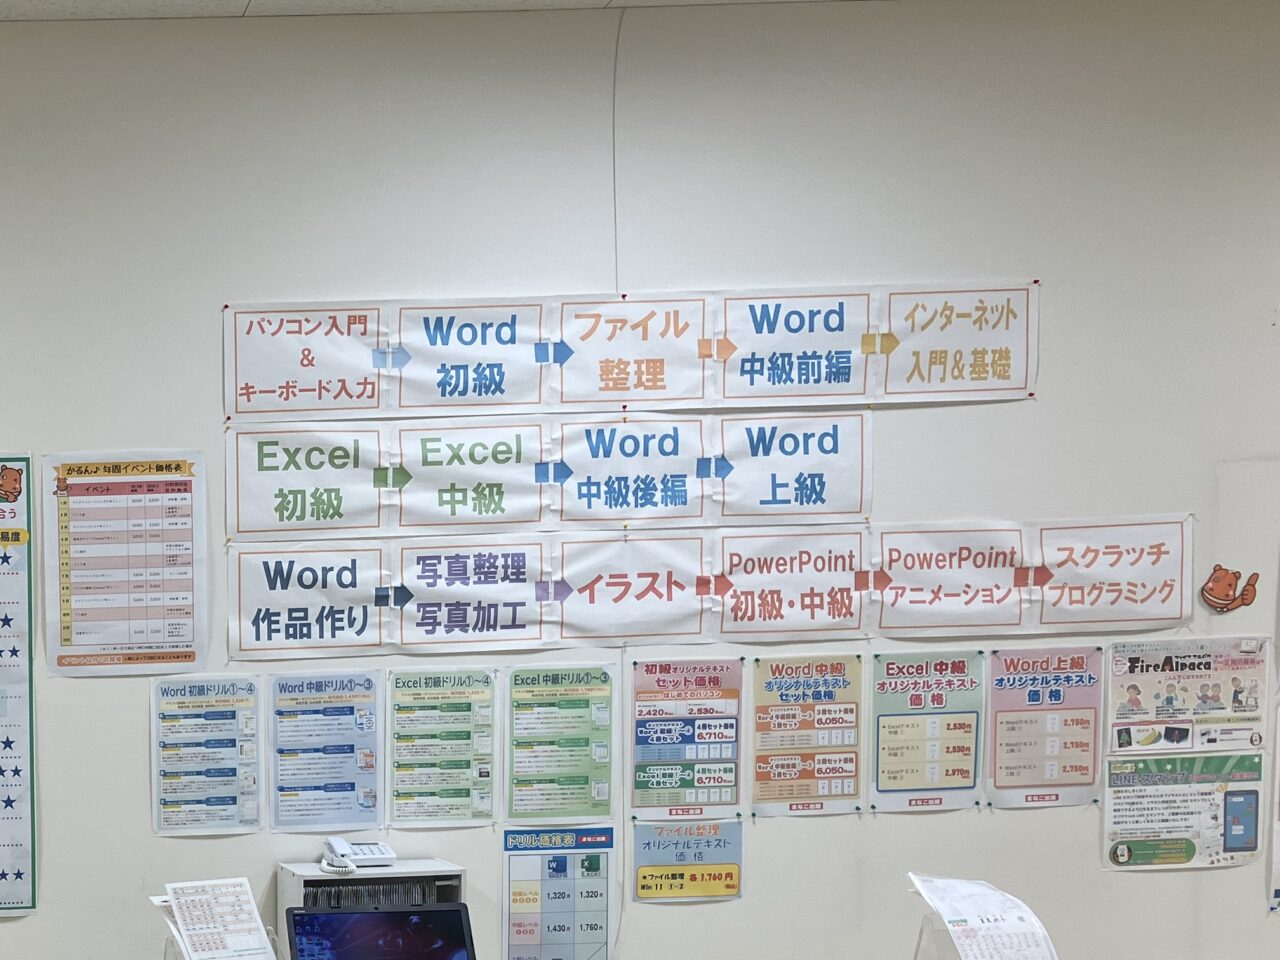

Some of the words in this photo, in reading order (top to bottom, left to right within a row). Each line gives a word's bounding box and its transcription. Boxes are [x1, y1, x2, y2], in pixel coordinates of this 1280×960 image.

[245, 314, 369, 337] パソコン入門
[573, 308, 691, 343] ファイル
[748, 302, 846, 335] Word
[903, 299, 1018, 332] インターネット
[423, 314, 518, 346] Word
[299, 347, 316, 368] &
[738, 349, 852, 386] 中級前編
[906, 347, 1012, 384] 入門&基礎
[436, 362, 506, 398] 初級
[597, 356, 668, 393] 整理
[238, 377, 377, 402] キーボード入力
[420, 434, 522, 467] Excel
[583, 426, 680, 459] Word
[745, 424, 839, 457] Word
[255, 439, 360, 472] Excel
[437, 482, 506, 517] 中級
[576, 473, 689, 510] 中級後編
[759, 471, 827, 507] 上級
[273, 488, 344, 522] 初級
[728, 549, 856, 575] PowerPoint
[887, 544, 1017, 572] PowerPoint
[1056, 543, 1171, 568] スクラッチ
[261, 559, 358, 591] Word
[415, 551, 527, 588] 写真整理
[577, 570, 688, 604] イラスト
[888, 582, 1014, 608] アニメーション
[1050, 578, 1176, 607] プログラミング
[730, 586, 855, 623] 初級・中級
[250, 607, 369, 642] 作品作り
[415, 602, 527, 637] 写真加工
[770, 663, 812, 678] Word
[815, 662, 846, 676] 中級
[885, 661, 929, 677] Excel
[933, 660, 968, 676] 中級
[1004, 657, 1051, 672] Word
[1052, 656, 1086, 671] 上級
[1128, 656, 1212, 674] FireAlpaca
[160, 686, 186, 698] Word
[278, 682, 304, 694] Word
[395, 677, 422, 689] Excel
[514, 674, 541, 686] Excel
[656, 676, 722, 688] セット価格
[764, 678, 850, 691] オリジナルテキスト
[876, 678, 979, 692] オリジナルテキスト
[995, 674, 1097, 688] オリジナルテキスト
[779, 690, 836, 702] セット価格
[908, 693, 946, 707] 価格
[1027, 689, 1063, 704] 価格
[817, 717, 844, 725] 6,050
[817, 767, 844, 775] 6,050
[508, 834, 575, 848] ドリル価格表
[654, 824, 720, 837] ファイル整理
[642, 839, 731, 850] オリジナルテキスト
[675, 851, 704, 862] 価格
[725, 872, 734, 881] 円
